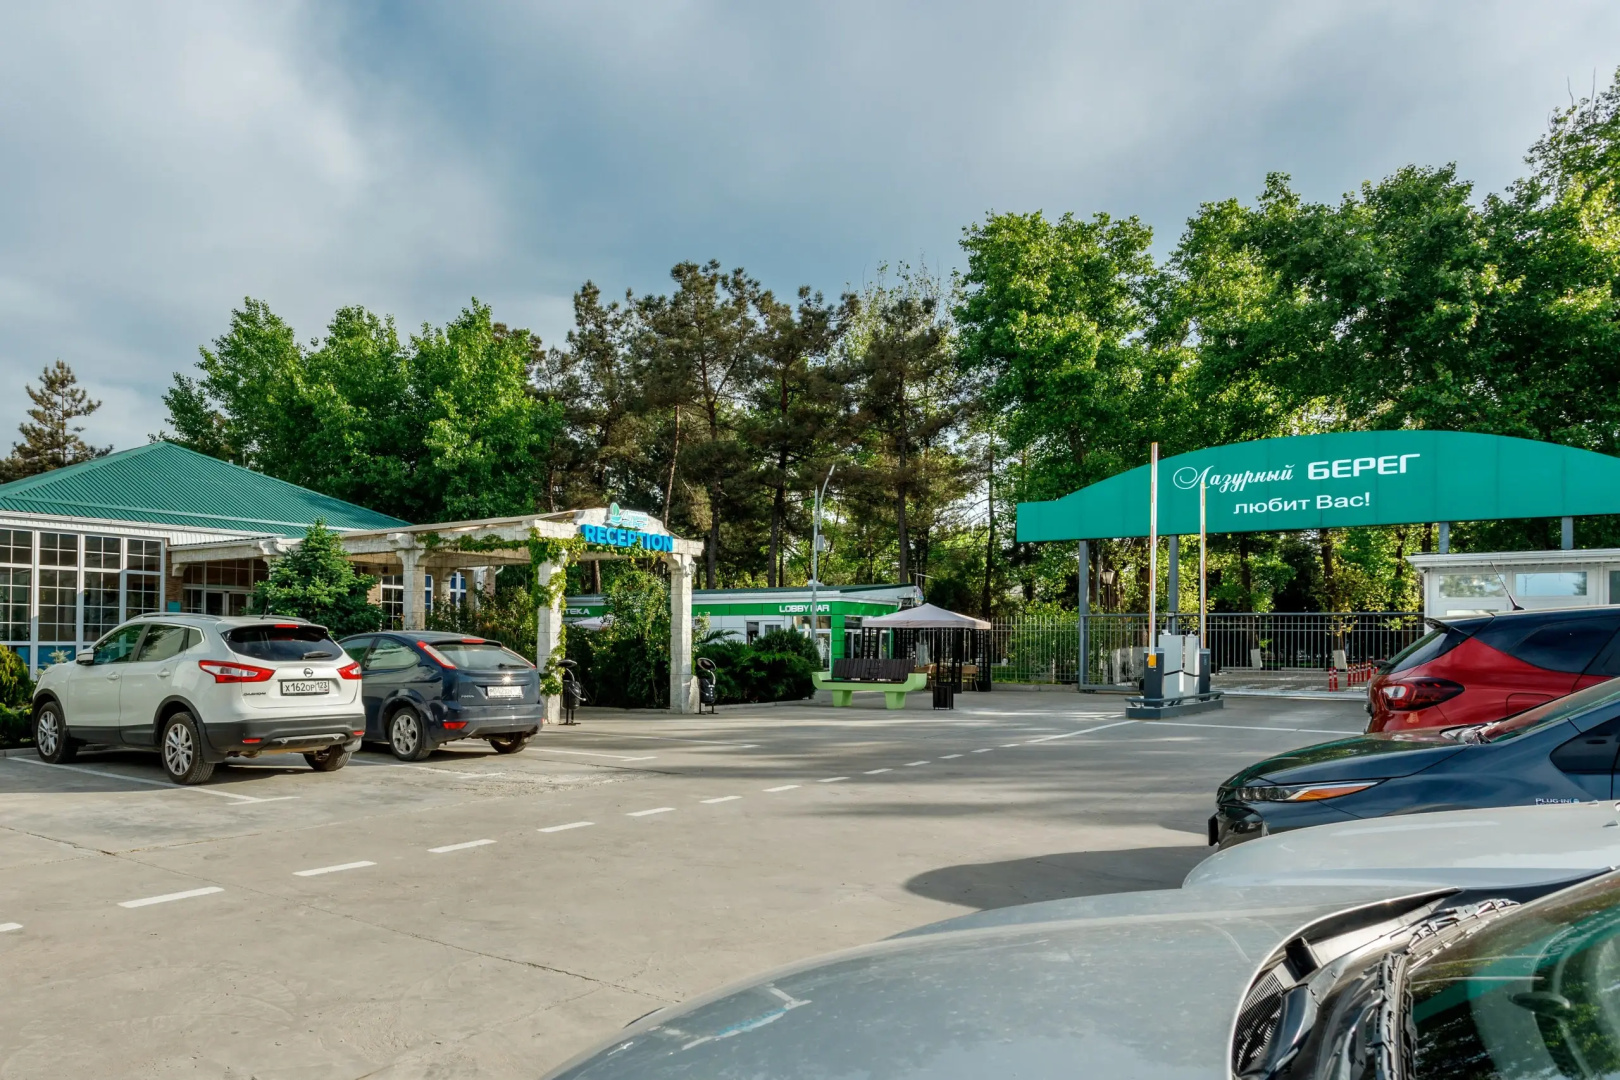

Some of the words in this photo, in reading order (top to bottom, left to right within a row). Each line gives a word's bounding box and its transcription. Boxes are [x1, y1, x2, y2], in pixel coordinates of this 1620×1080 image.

[1173, 464, 1296, 493] Лазурный
[1307, 453, 1421, 481] БЕРЕГ
[1233, 497, 1311, 515] любит
[1316, 492, 1371, 510] Вас!
[582, 524, 674, 553] RECEPTION
[779, 604, 809, 613] LOBBY
